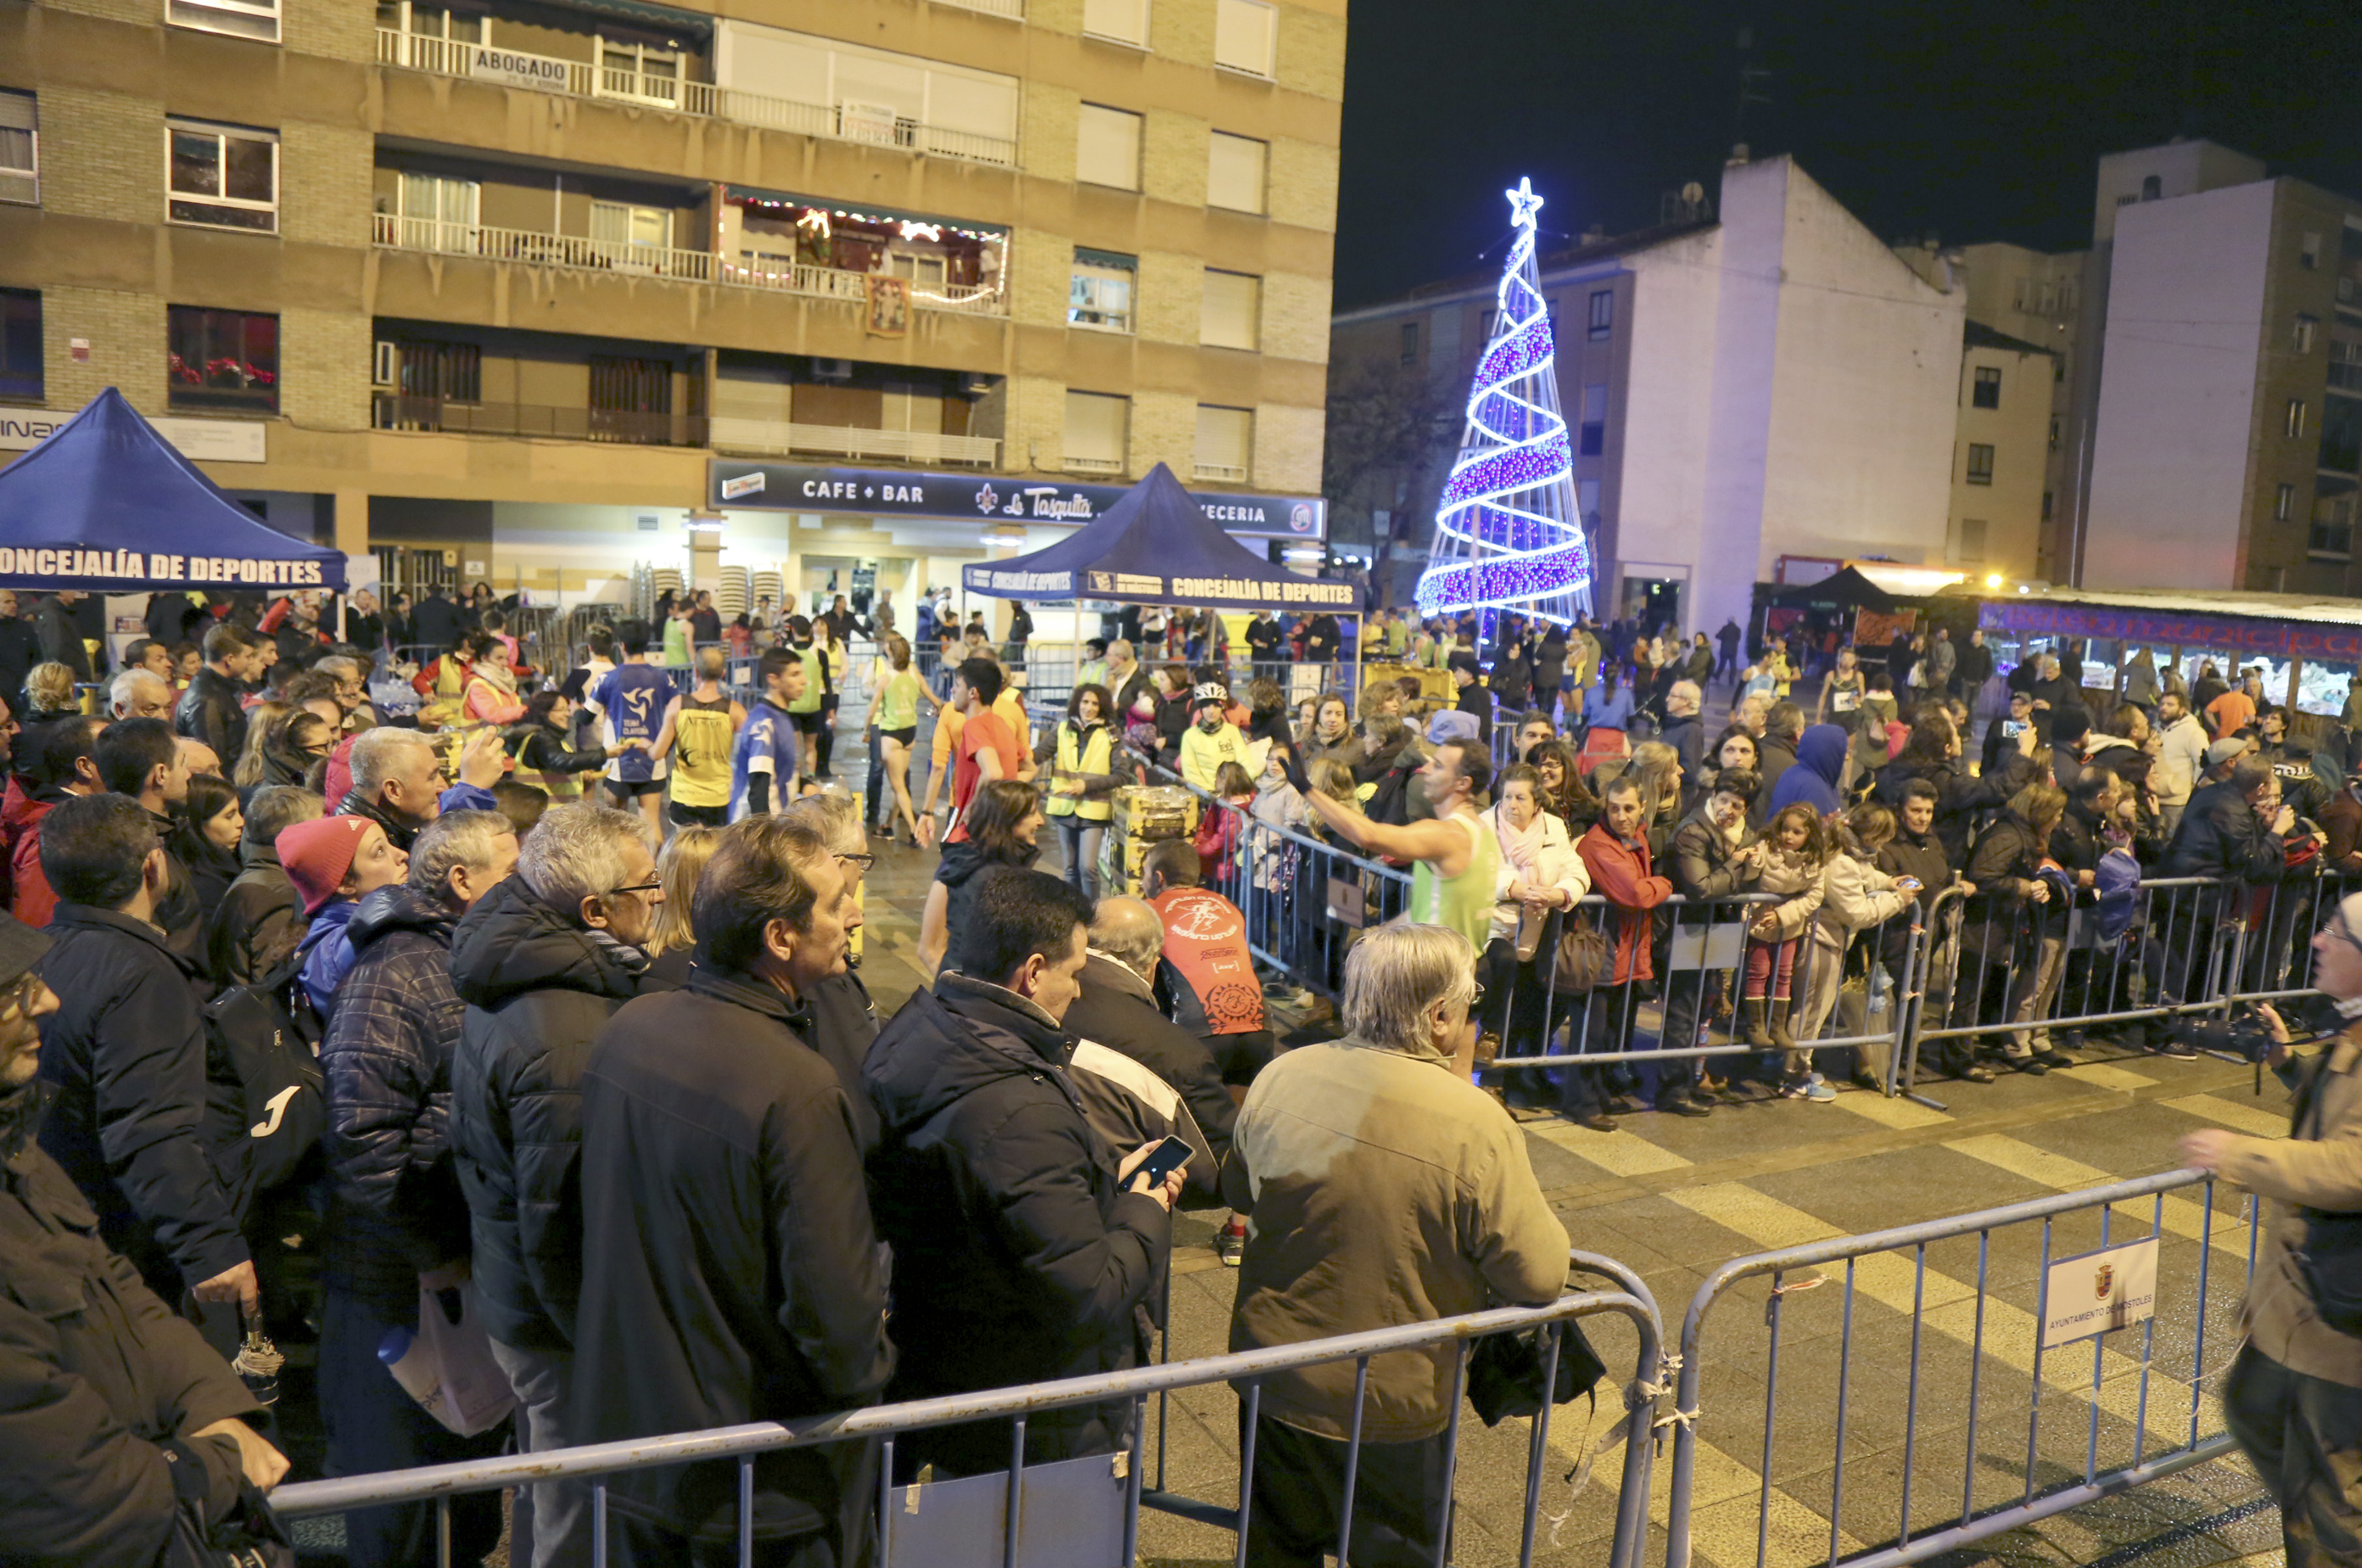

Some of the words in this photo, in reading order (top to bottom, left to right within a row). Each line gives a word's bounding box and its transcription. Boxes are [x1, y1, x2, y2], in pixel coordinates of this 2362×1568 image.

[477, 51, 565, 81] ABOGADO
[803, 480, 857, 499] CAFE
[882, 484, 923, 503] BAR
[150, 554, 184, 580] DE
[190, 557, 322, 585] DEPORTES
[1173, 577, 1261, 601] CONCEJALÍA
[1262, 581, 1280, 602] DE
[1283, 583, 1353, 604] DEPORTES
[2049, 1308, 2105, 1330] AYUNTAMIENTO
[2106, 1305, 2115, 1314] DE
